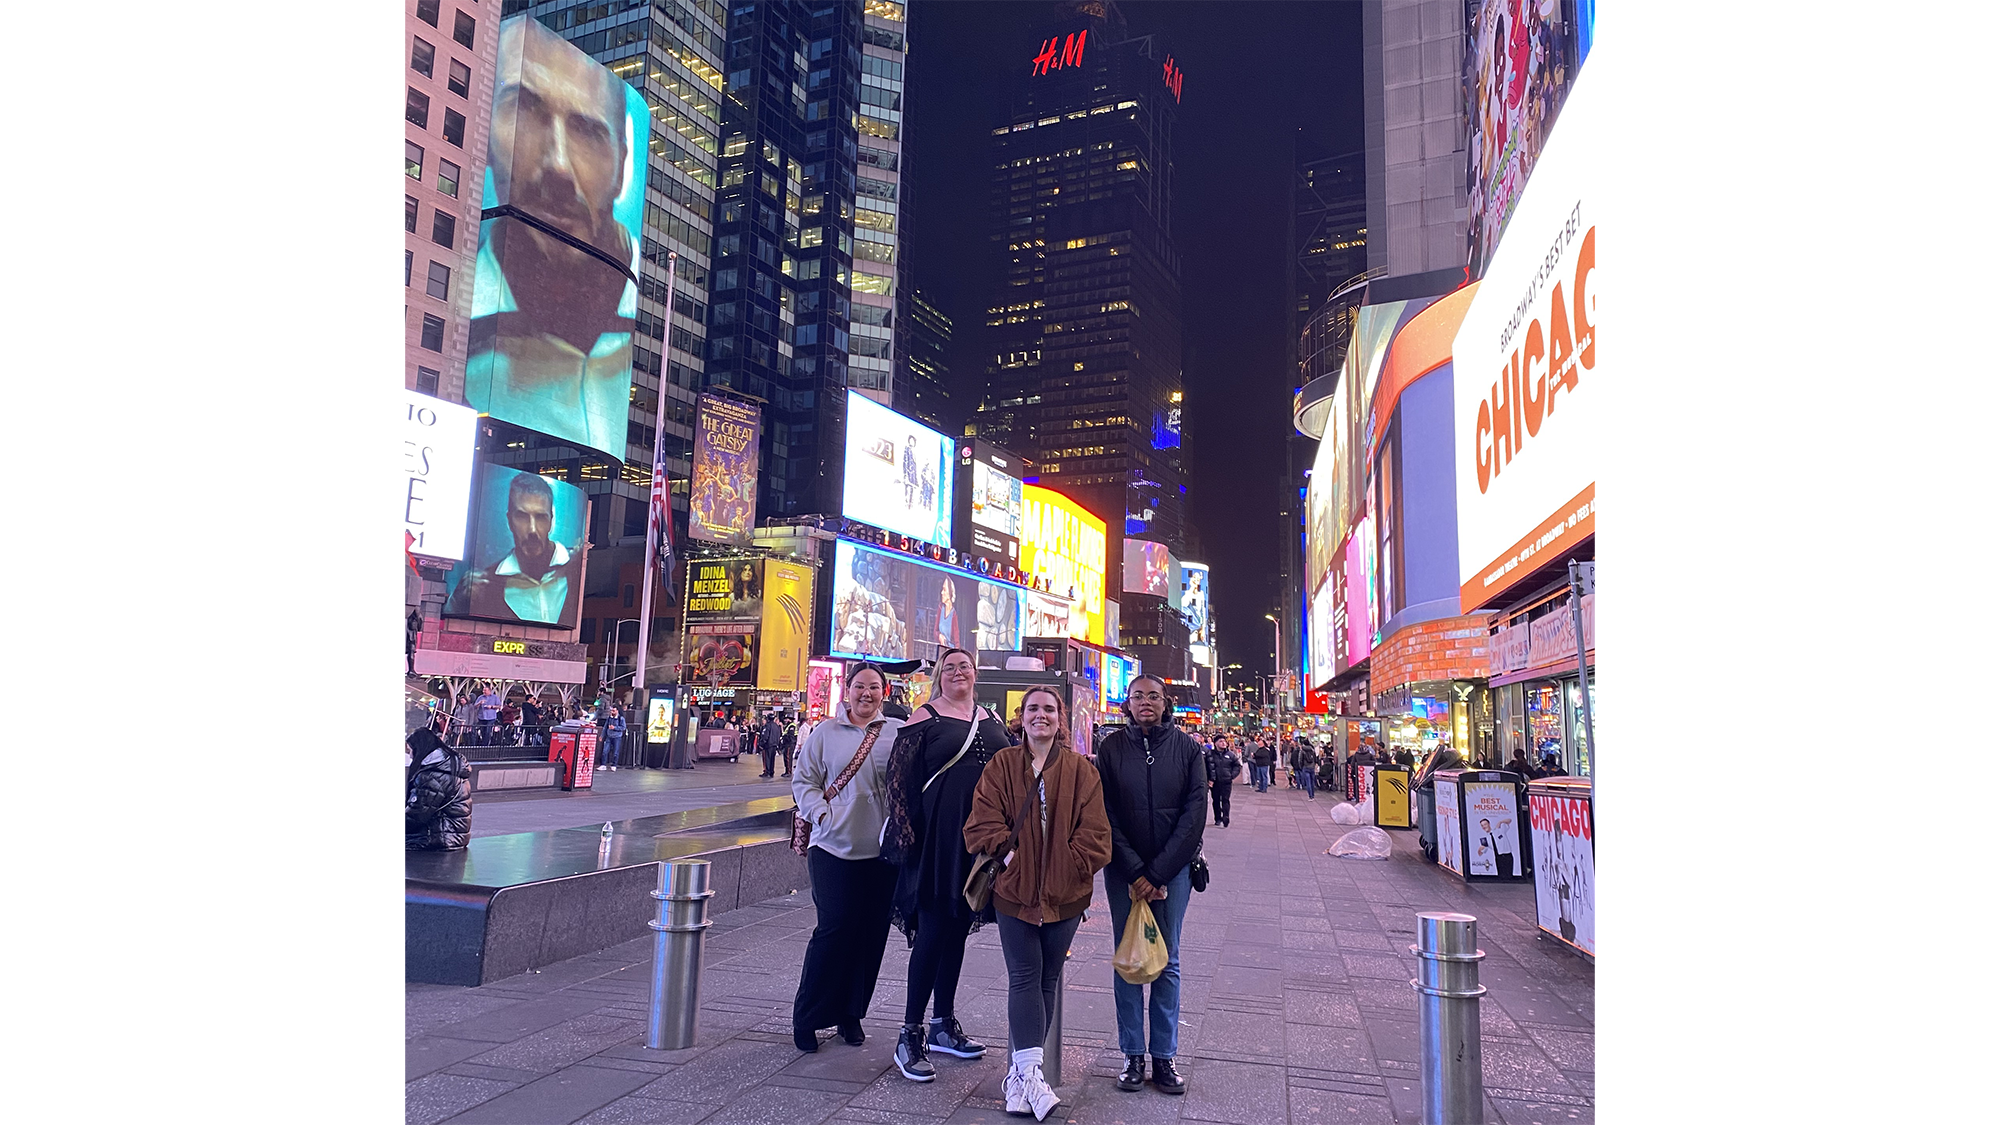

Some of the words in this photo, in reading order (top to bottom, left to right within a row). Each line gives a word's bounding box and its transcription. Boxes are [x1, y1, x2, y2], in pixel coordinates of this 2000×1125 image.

[1032, 29, 1088, 77] H&M
[1162, 53, 1183, 105] H&M
[1501, 264, 1544, 354] BROADWAY'S
[1545, 230, 1564, 280] BEST
[1565, 199, 1581, 247] BET
[702, 417, 720, 432] THE
[721, 421, 755, 441] GREAT
[706, 431, 748, 452] GATSBY
[961, 458, 972, 466] LG
[1022, 499, 1070, 557] MAPLE
[693, 579, 730, 594] MENZEL
[699, 566, 726, 580] IDINA
[948, 548, 1052, 593] BROADWAY
[689, 598, 731, 611] REDWOOD
[1530, 795, 1591, 841] CHICAGO
